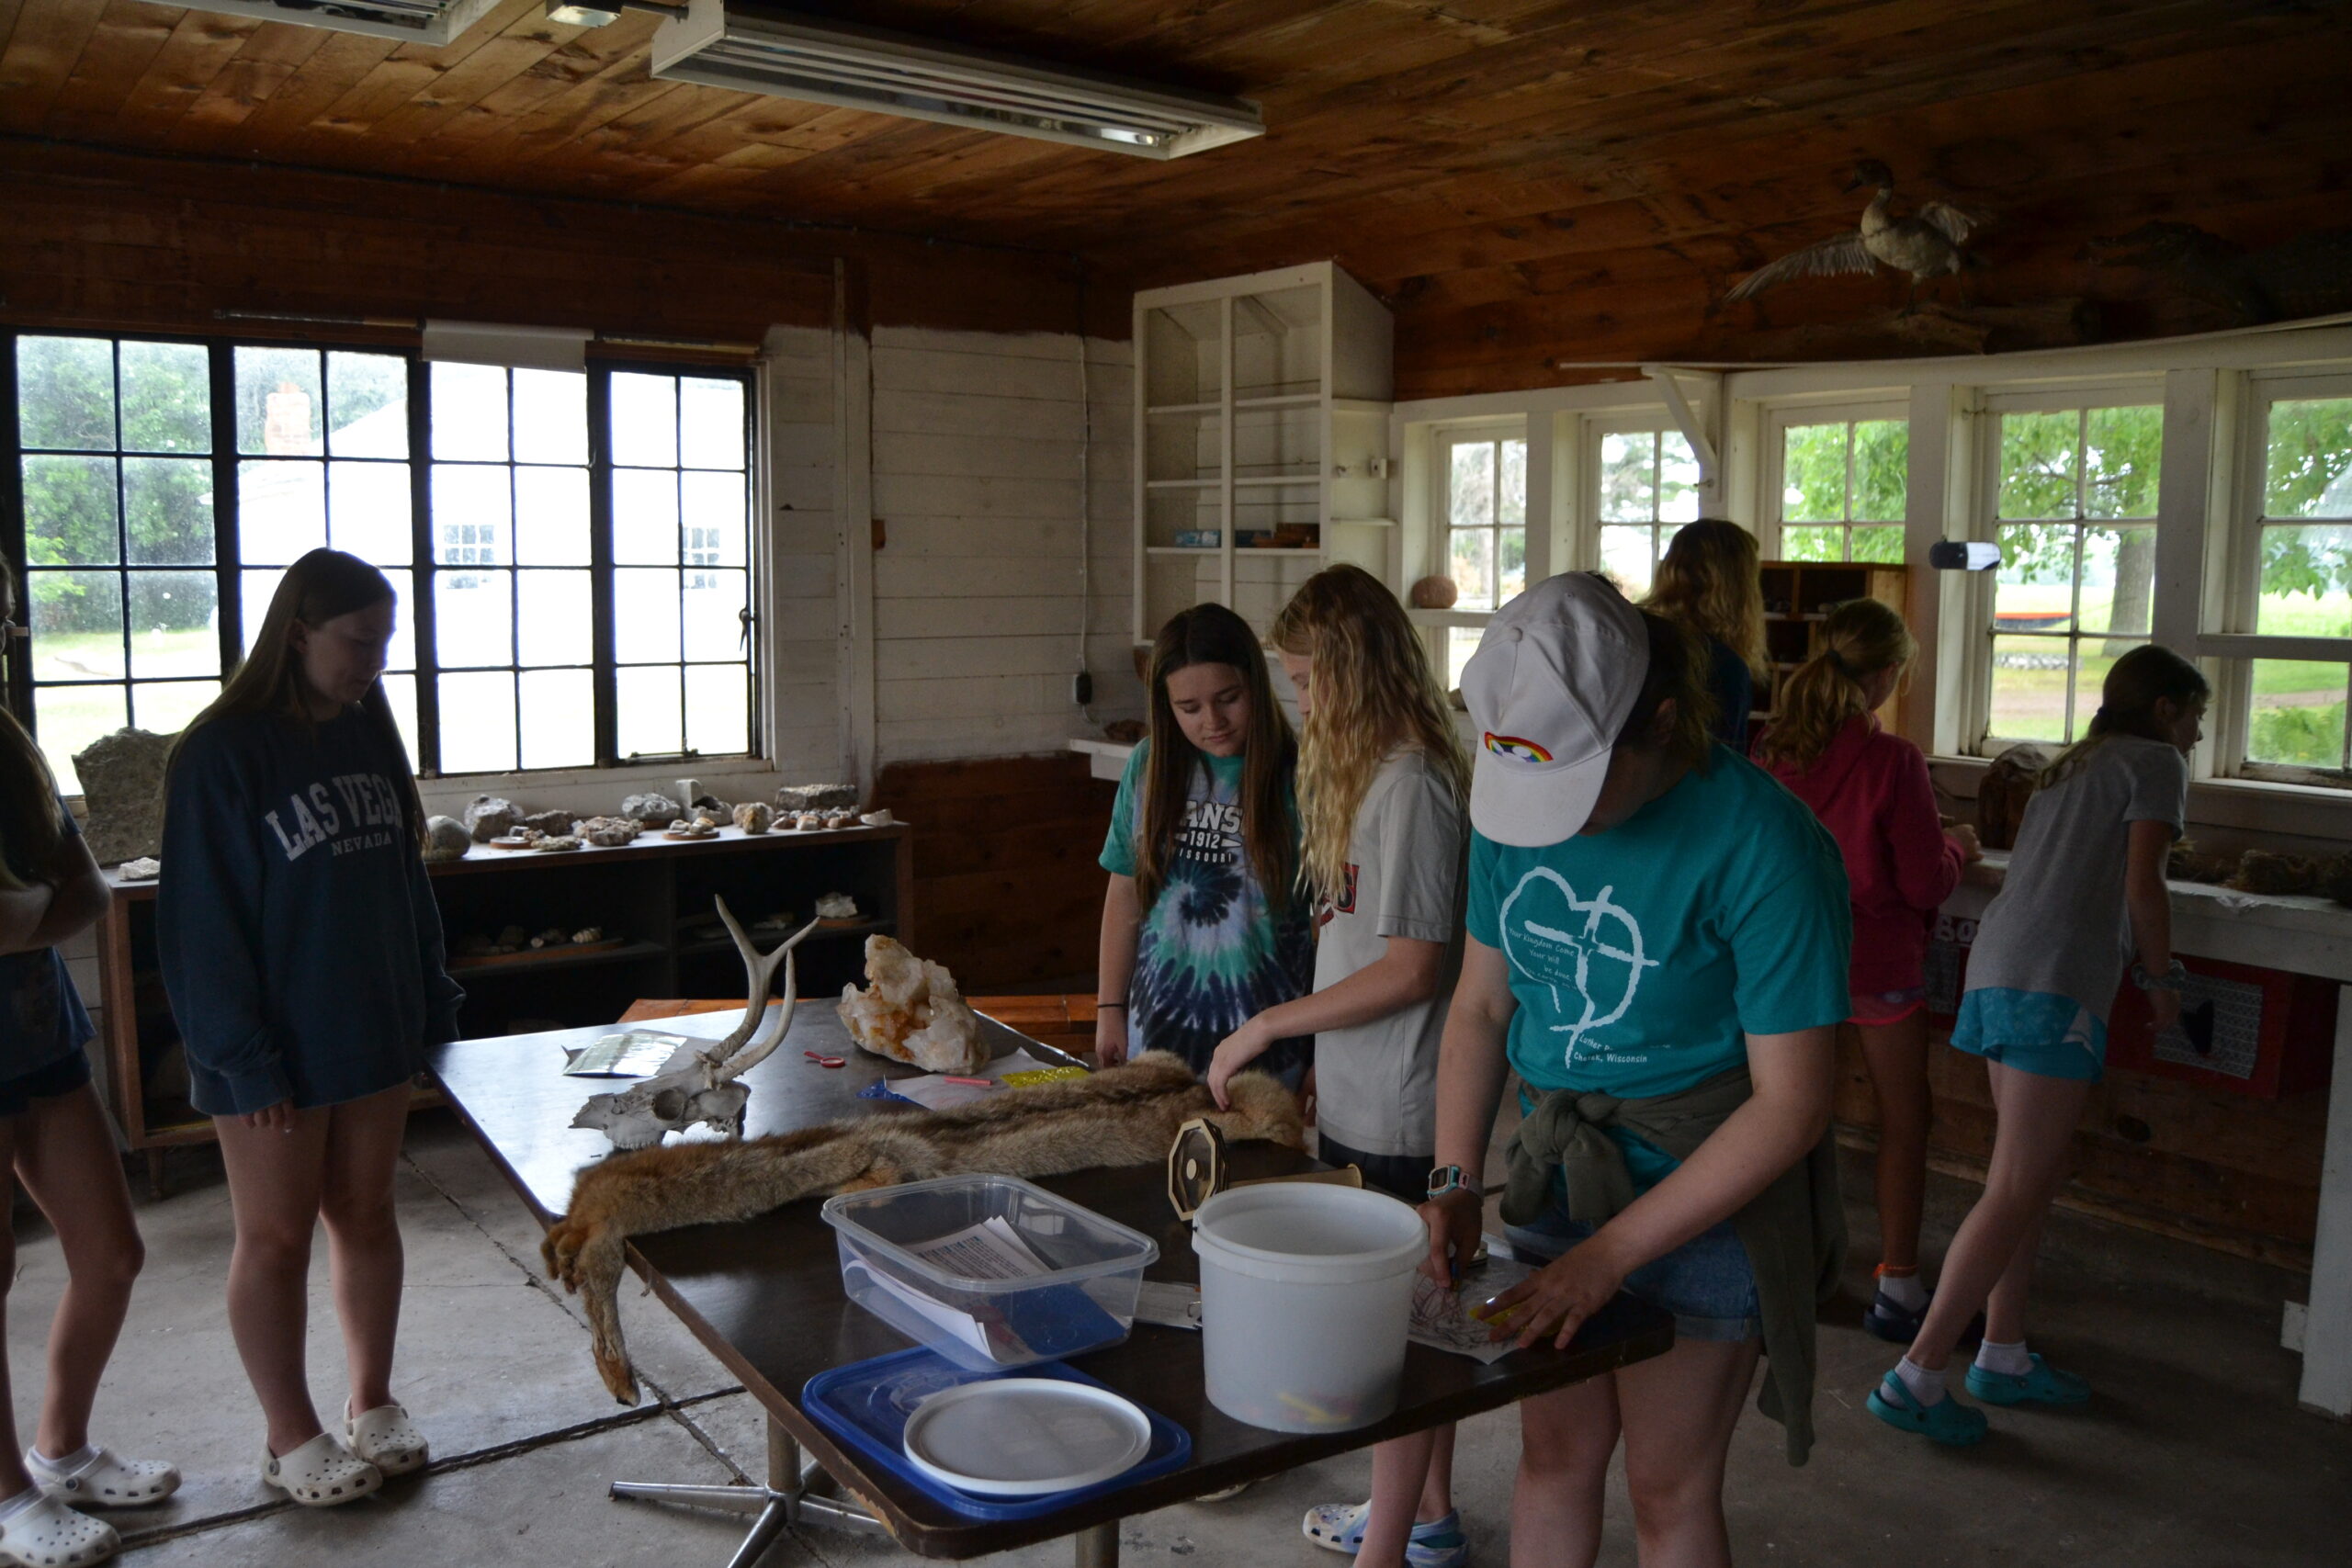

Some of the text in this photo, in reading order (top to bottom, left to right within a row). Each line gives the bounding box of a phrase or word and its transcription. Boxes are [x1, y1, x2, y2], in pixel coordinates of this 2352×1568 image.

[265, 773, 403, 862] LAS VEGA
[331, 831, 393, 856] NEVADA
[1190, 830, 1221, 850] 1912
[1179, 848, 1232, 863] ISSOURI
[1509, 927, 1522, 939] Your
[1523, 933, 1553, 949] Kingdom
[1529, 949, 1545, 960] Your
[1579, 1033, 1603, 1050] Luther
[1607, 1054, 1647, 1063] Wisconsin
